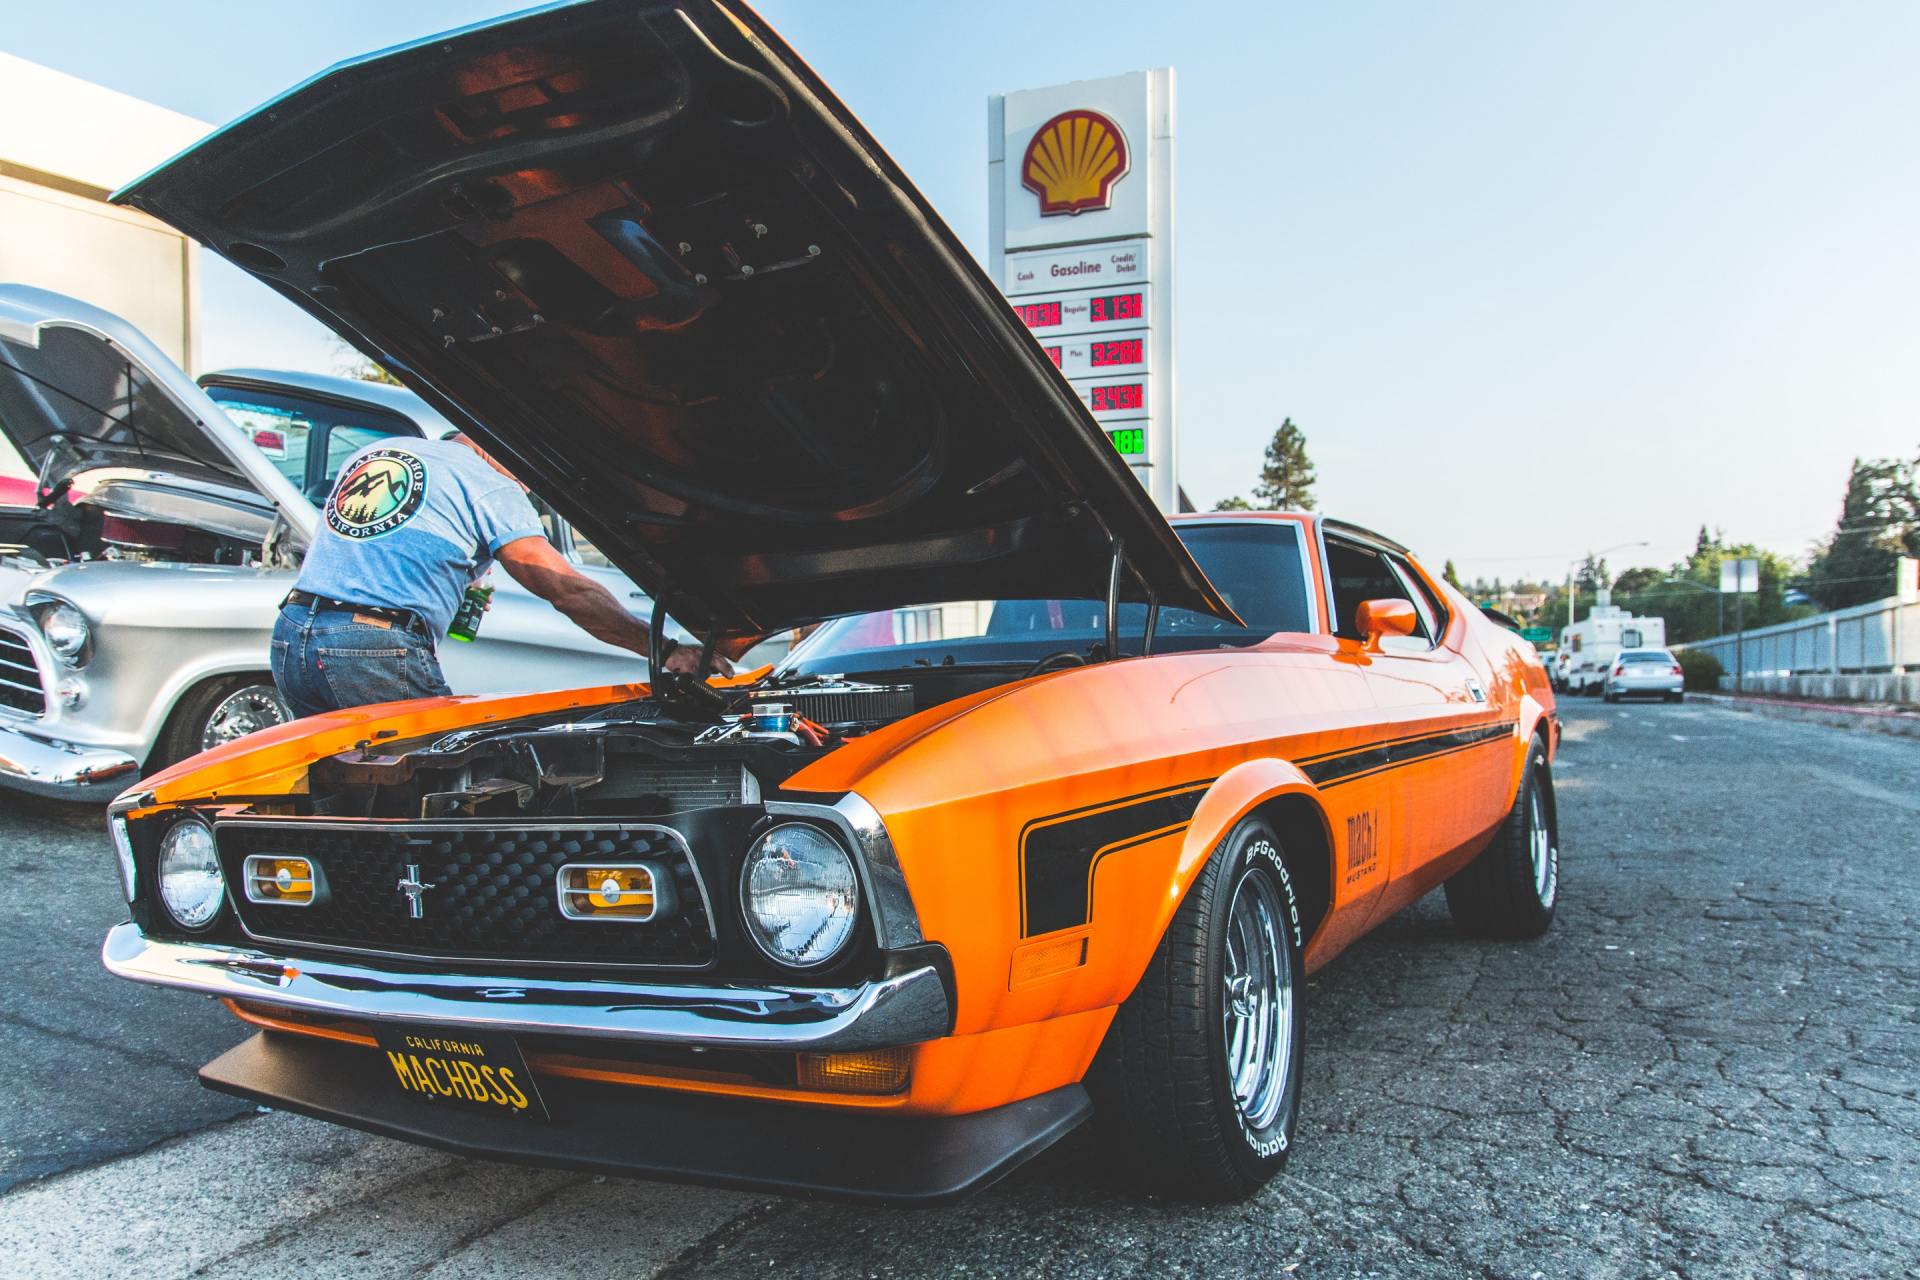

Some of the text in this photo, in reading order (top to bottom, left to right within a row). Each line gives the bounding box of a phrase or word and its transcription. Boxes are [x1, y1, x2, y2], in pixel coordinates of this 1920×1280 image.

[1017, 271, 1034, 281] Cash
[1050, 261, 1102, 277] Gasoline
[1116, 263, 1137, 273] Debit
[1064, 305, 1088, 314] Regular
[345, 450, 424, 492] LAKE TAHOE
[327, 497, 409, 537] CALIFORNIA
[405, 1035, 485, 1057] CALIFORNIA
[387, 1050, 529, 1109] MACHBSS
[1246, 1130, 1288, 1159] Radial
